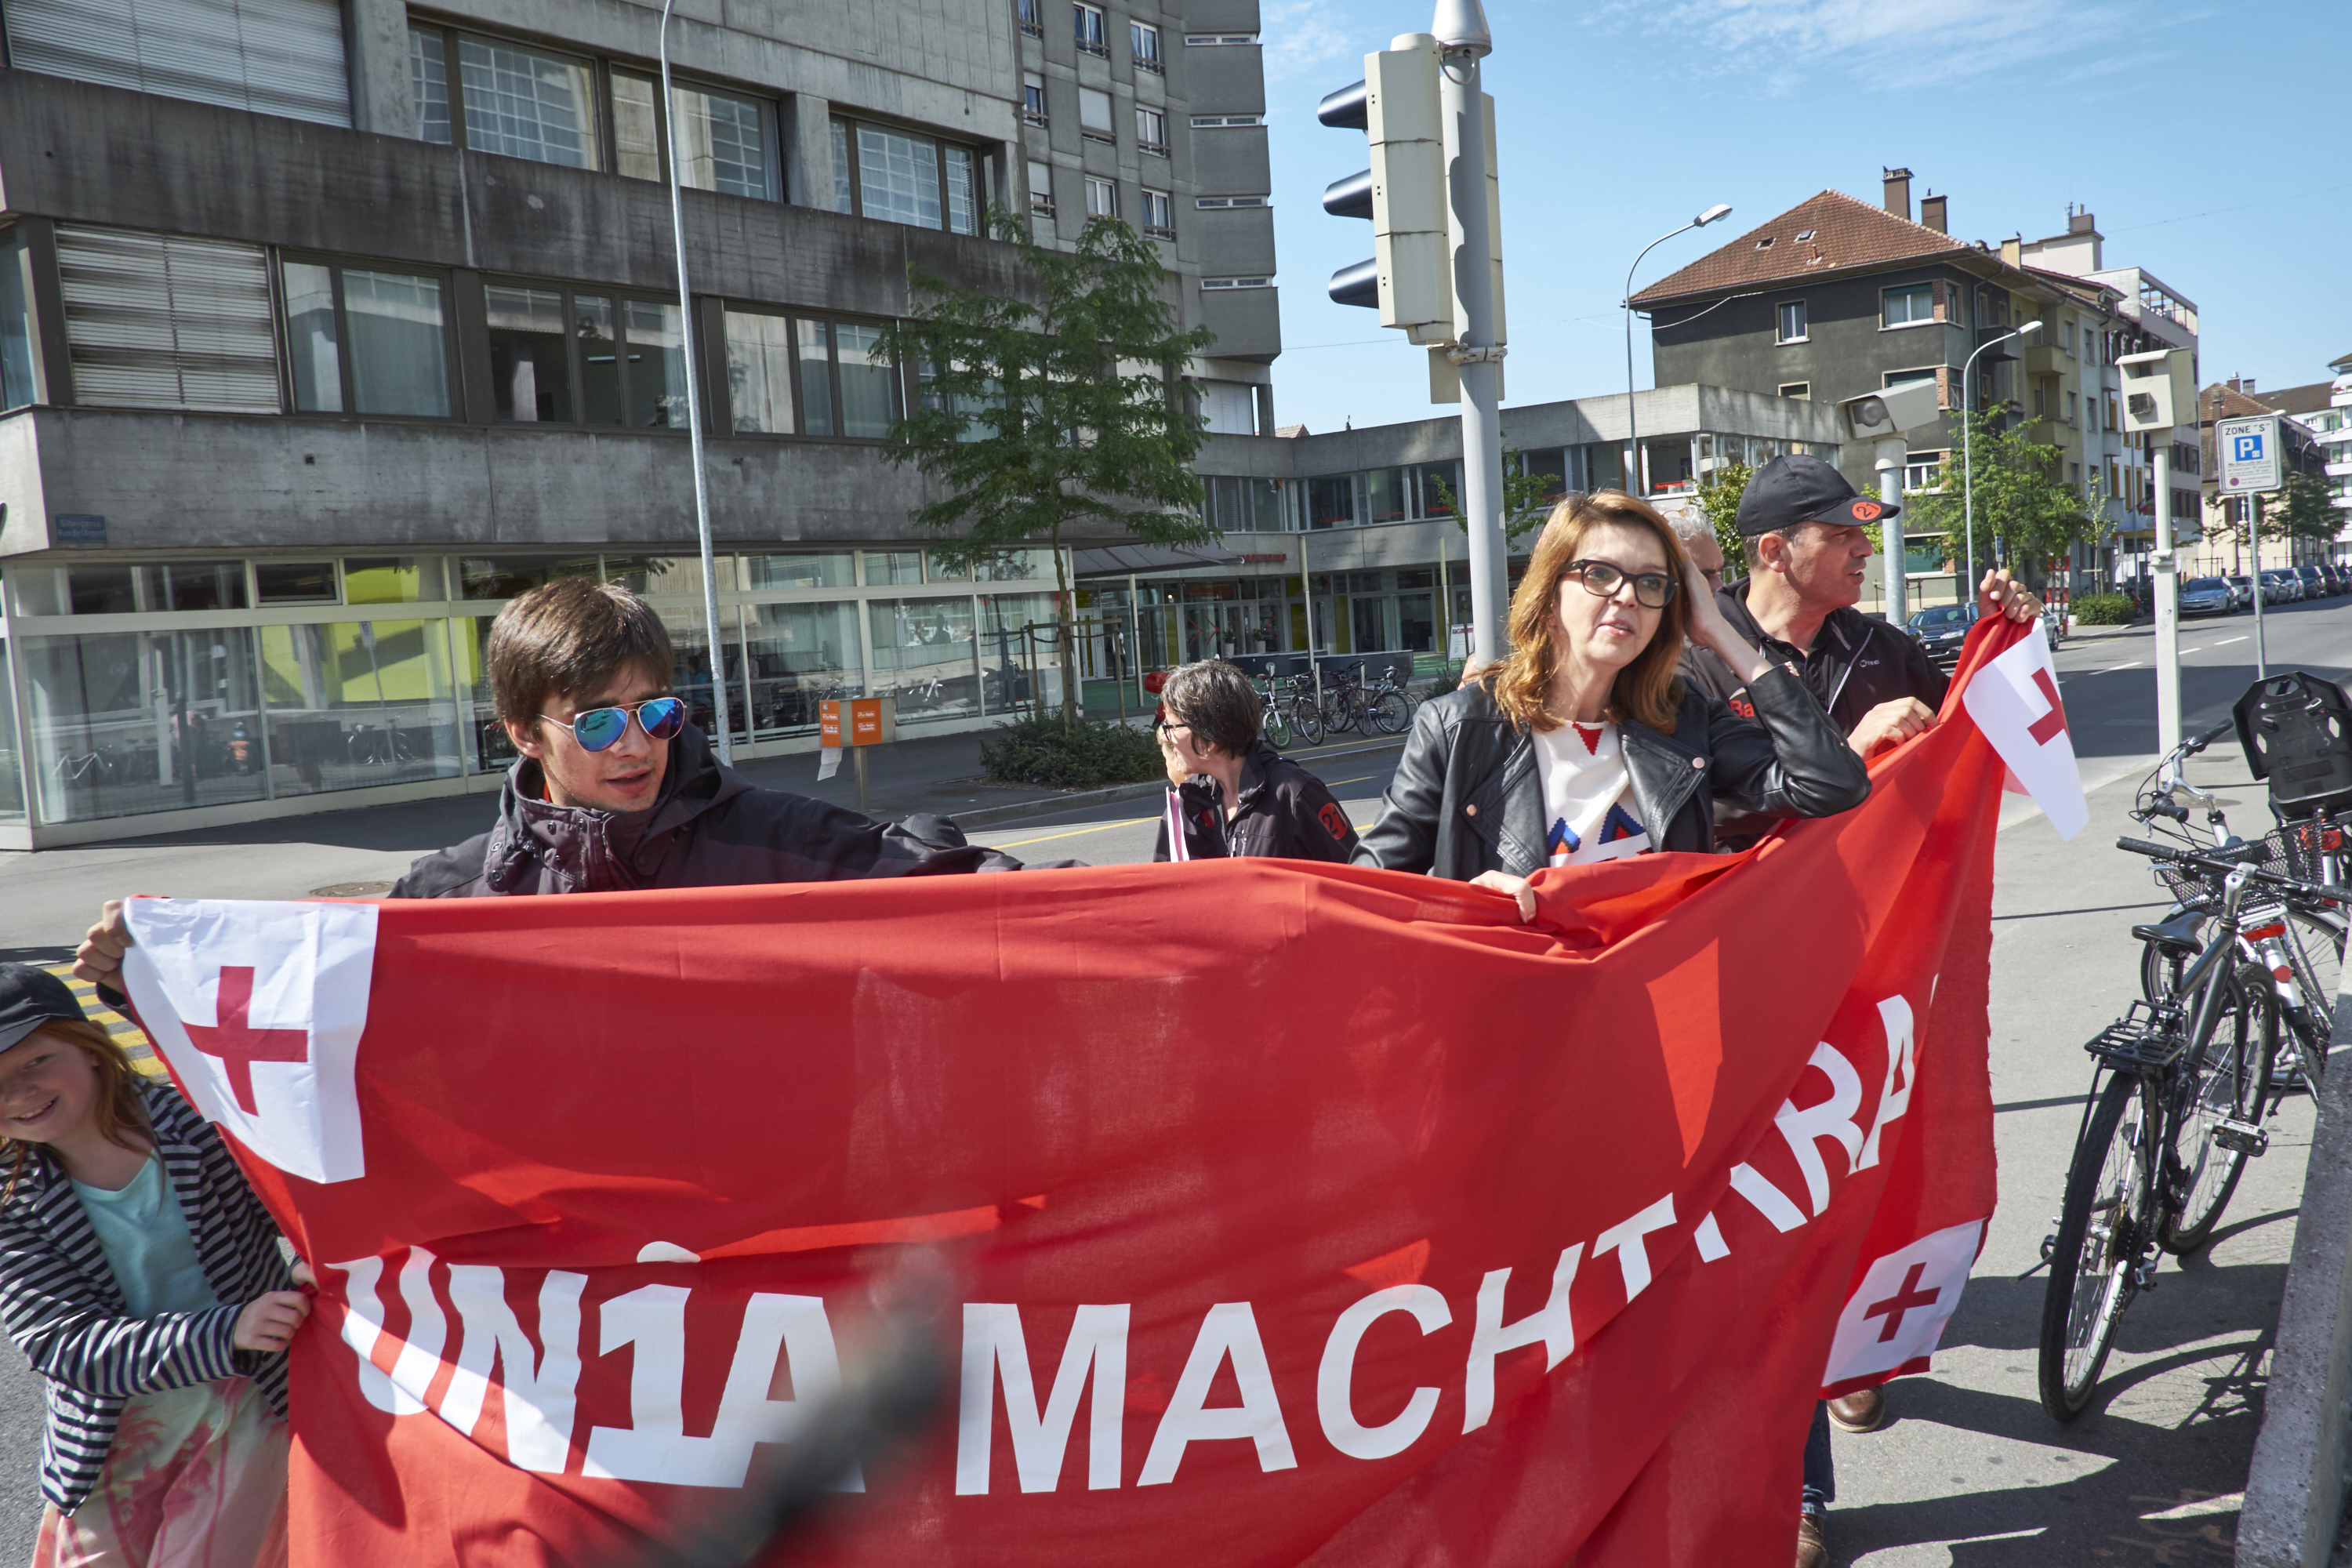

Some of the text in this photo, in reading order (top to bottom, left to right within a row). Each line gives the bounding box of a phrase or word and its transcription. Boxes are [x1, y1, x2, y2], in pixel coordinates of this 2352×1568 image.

[2225, 425, 2252, 435] ZONE
[2239, 438, 2254, 459] P
[1856, 502, 1879, 518] 21
[1321, 805, 1346, 836] 21
[955, 1193, 1676, 1495] MACHT
